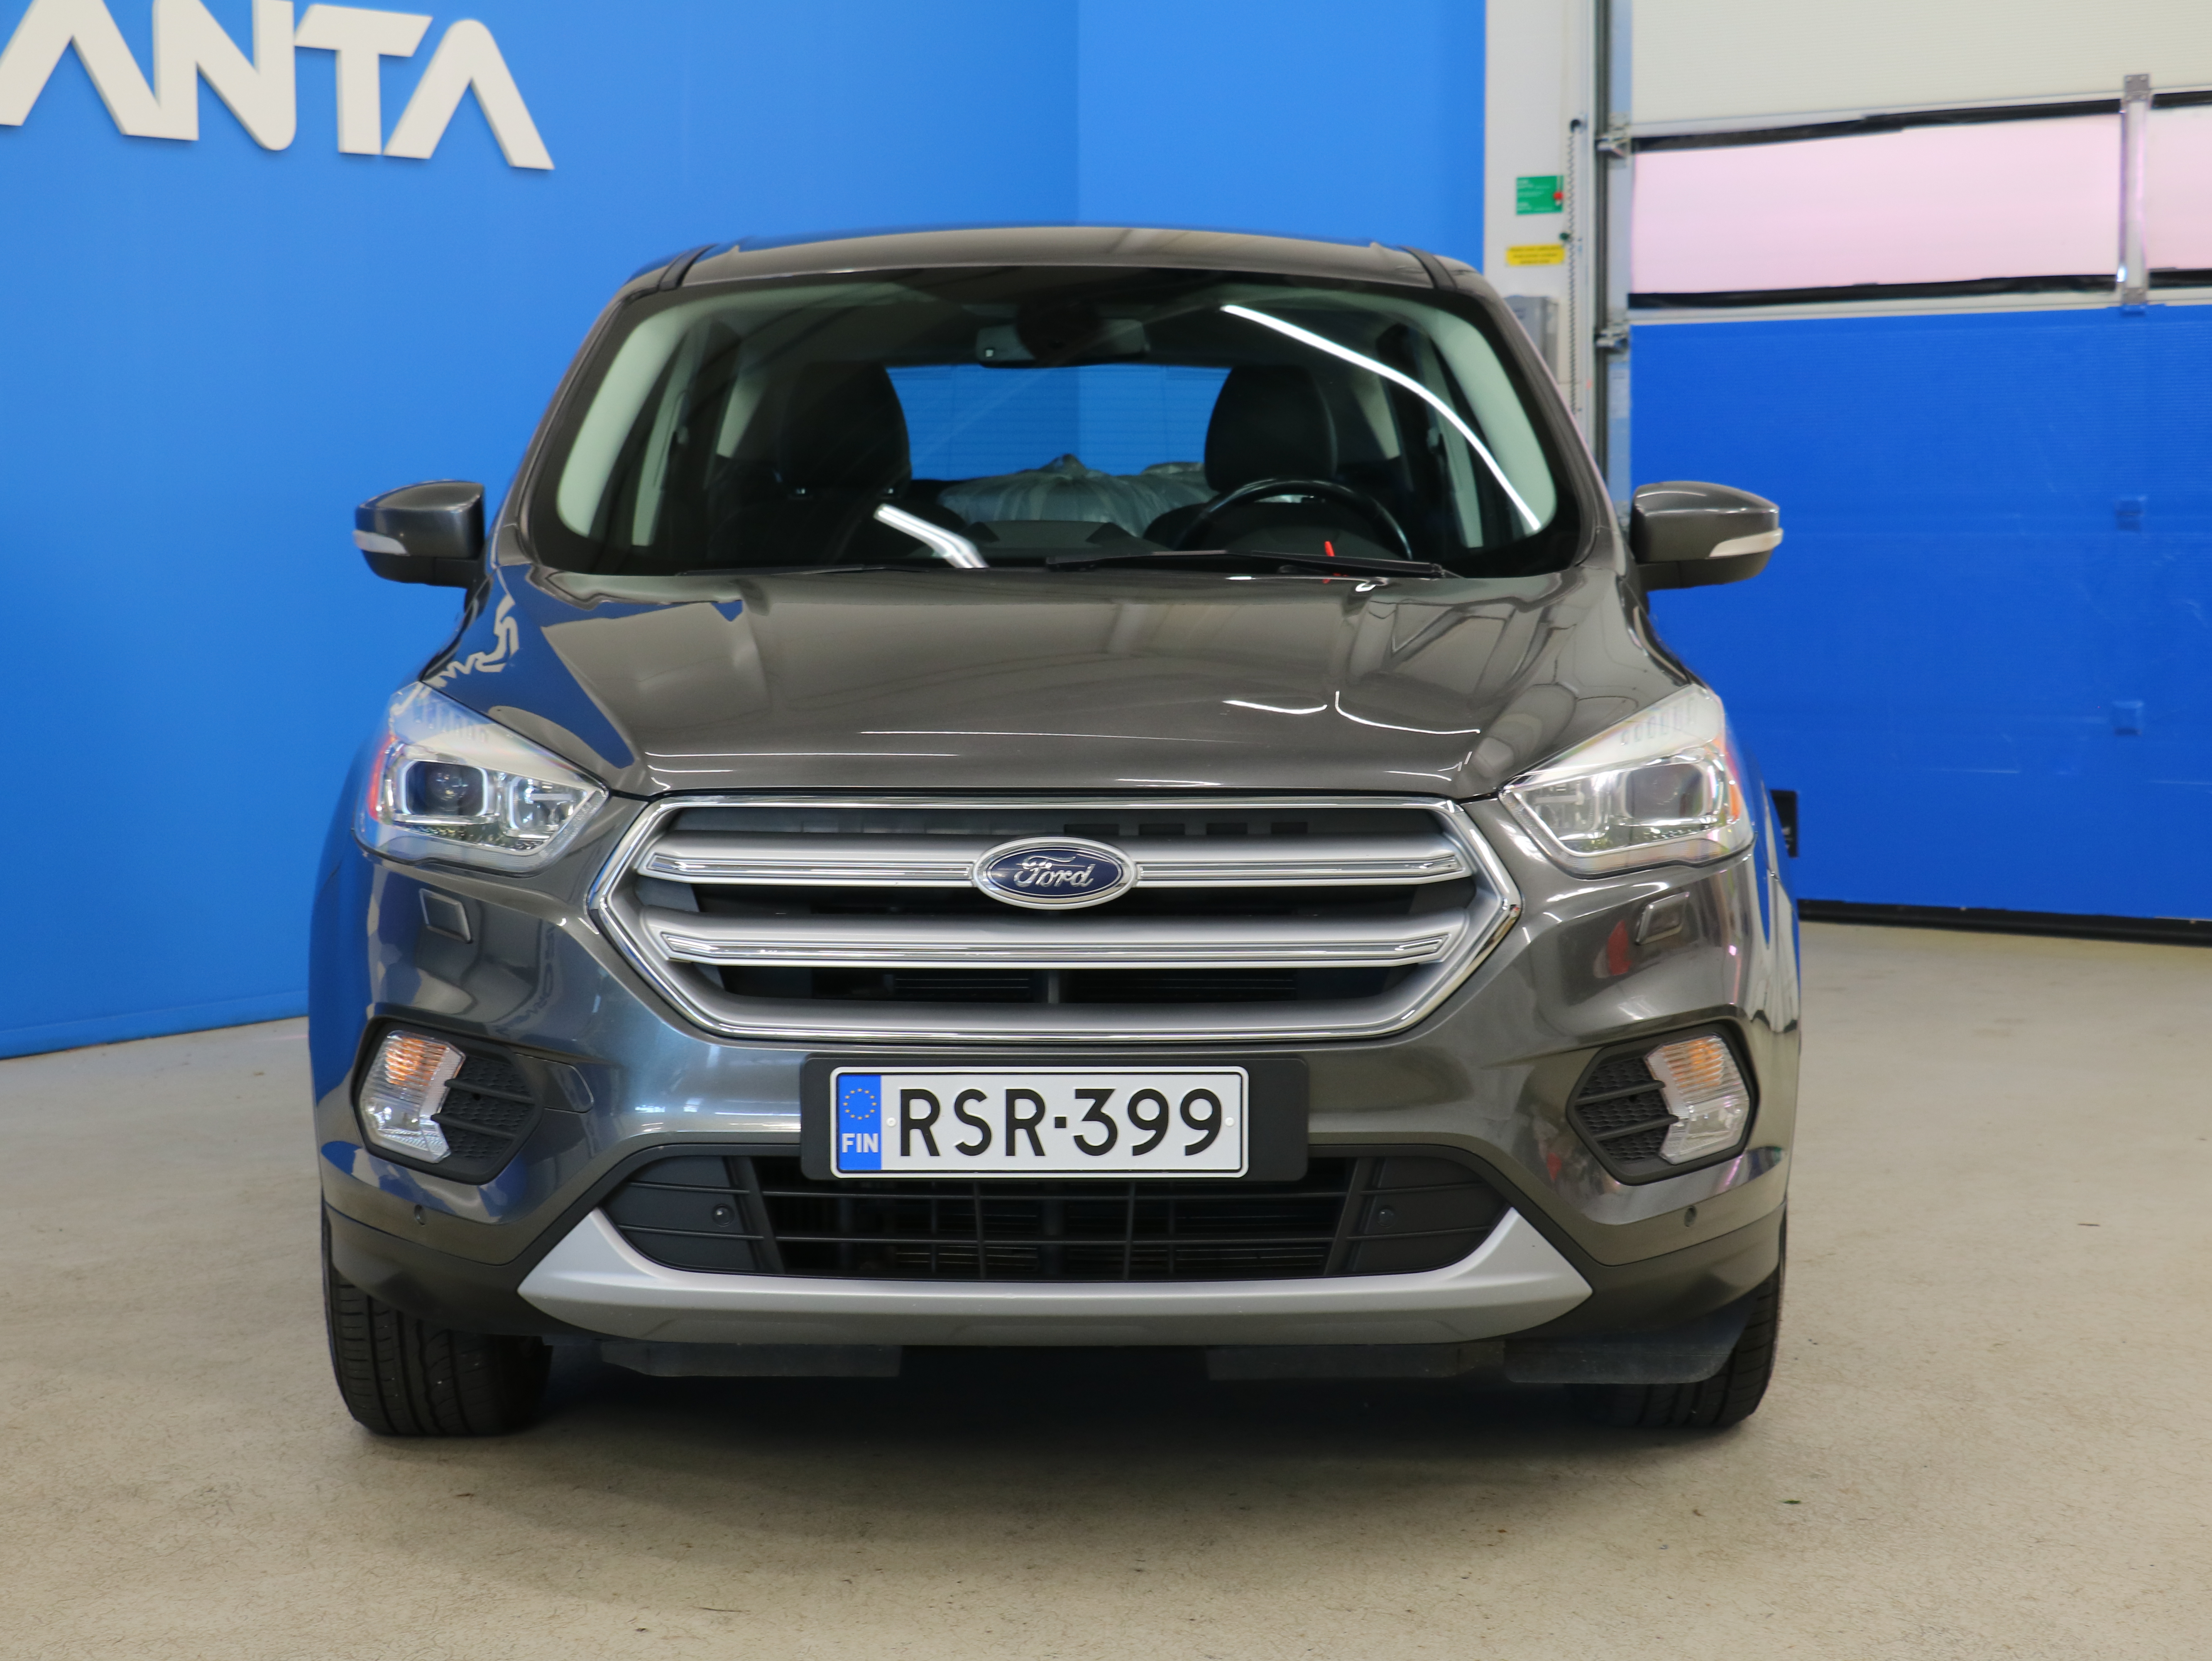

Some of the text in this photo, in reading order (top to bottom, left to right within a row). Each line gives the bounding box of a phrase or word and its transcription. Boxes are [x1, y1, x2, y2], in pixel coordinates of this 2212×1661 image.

[1013, 855, 1096, 887] Ford
[899, 1088, 1223, 1157] RSR-399
[842, 1132, 879, 1154] FIN
